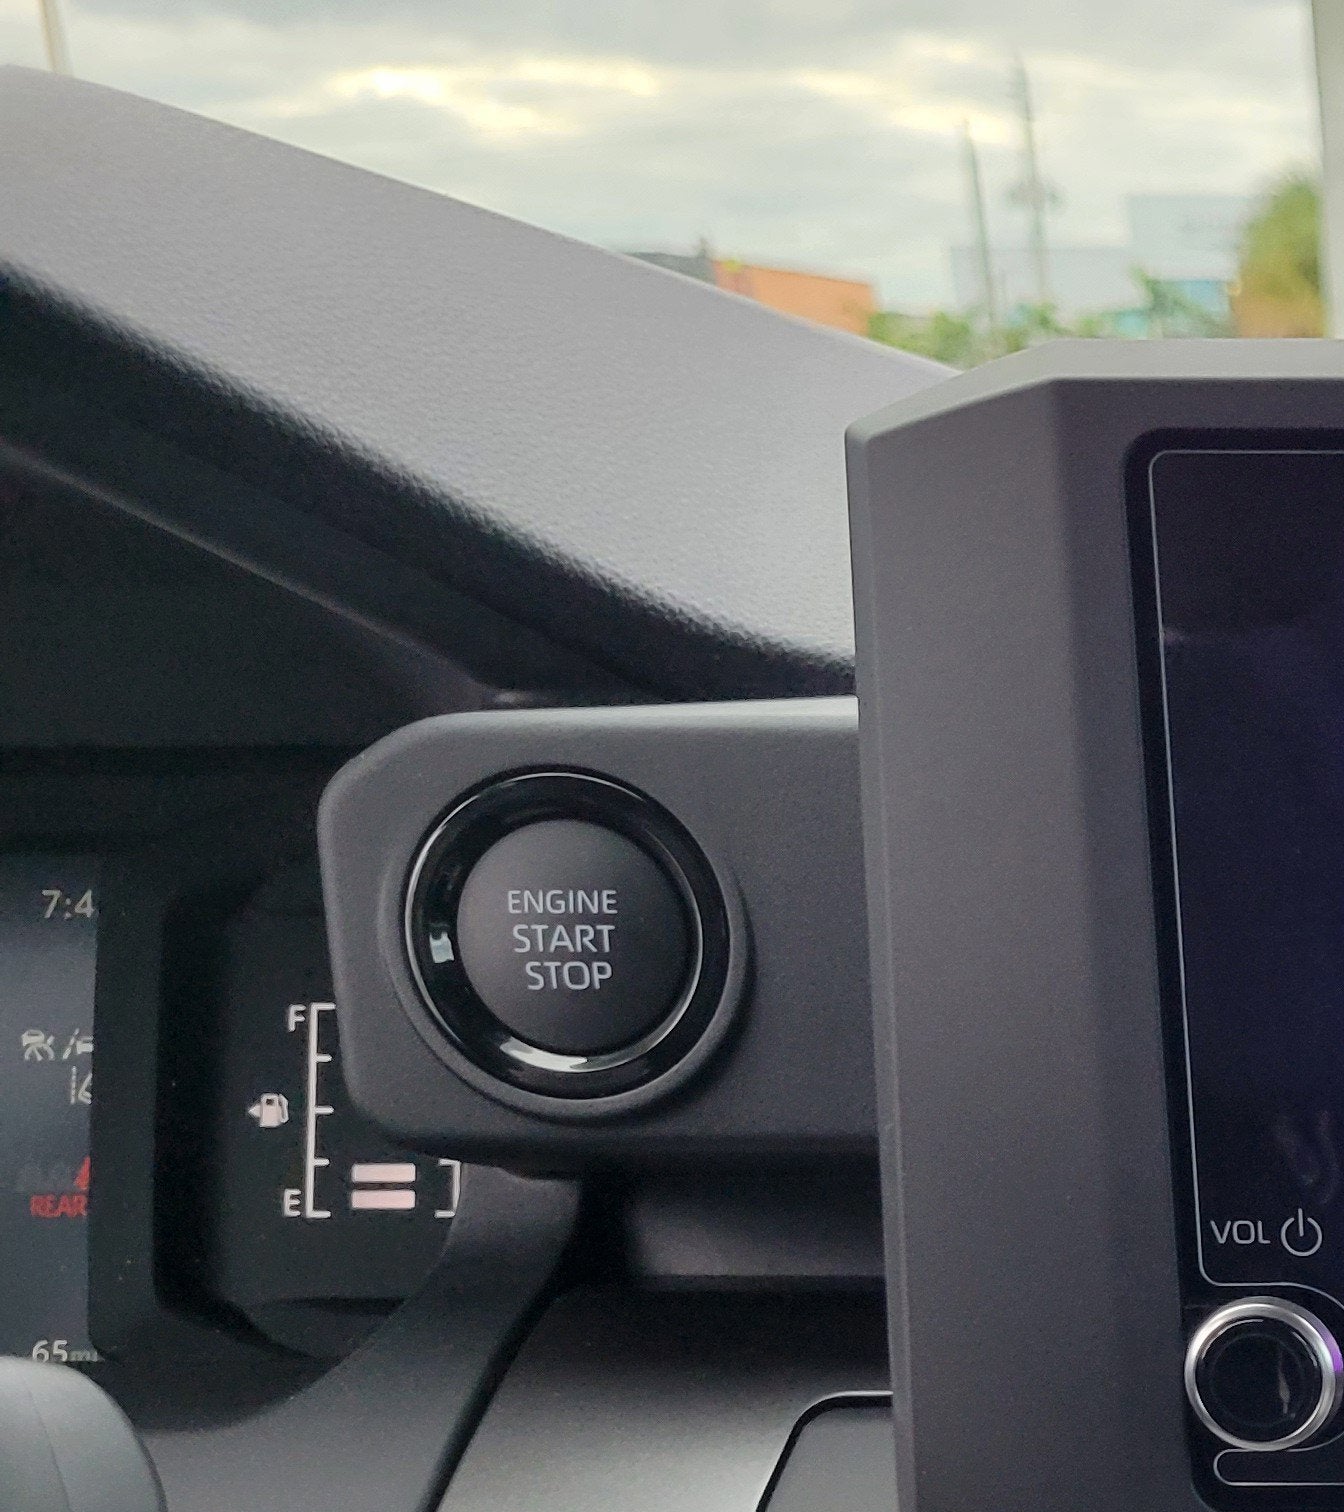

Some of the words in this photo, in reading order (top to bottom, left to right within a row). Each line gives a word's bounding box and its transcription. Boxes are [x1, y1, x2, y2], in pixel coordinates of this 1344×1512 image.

[507, 889, 618, 914] ENGINE
[512, 924, 616, 953] START
[525, 961, 613, 991] STOP
[288, 1004, 306, 1033] F
[284, 1188, 302, 1217] E
[1210, 1220, 1271, 1245] VOL
